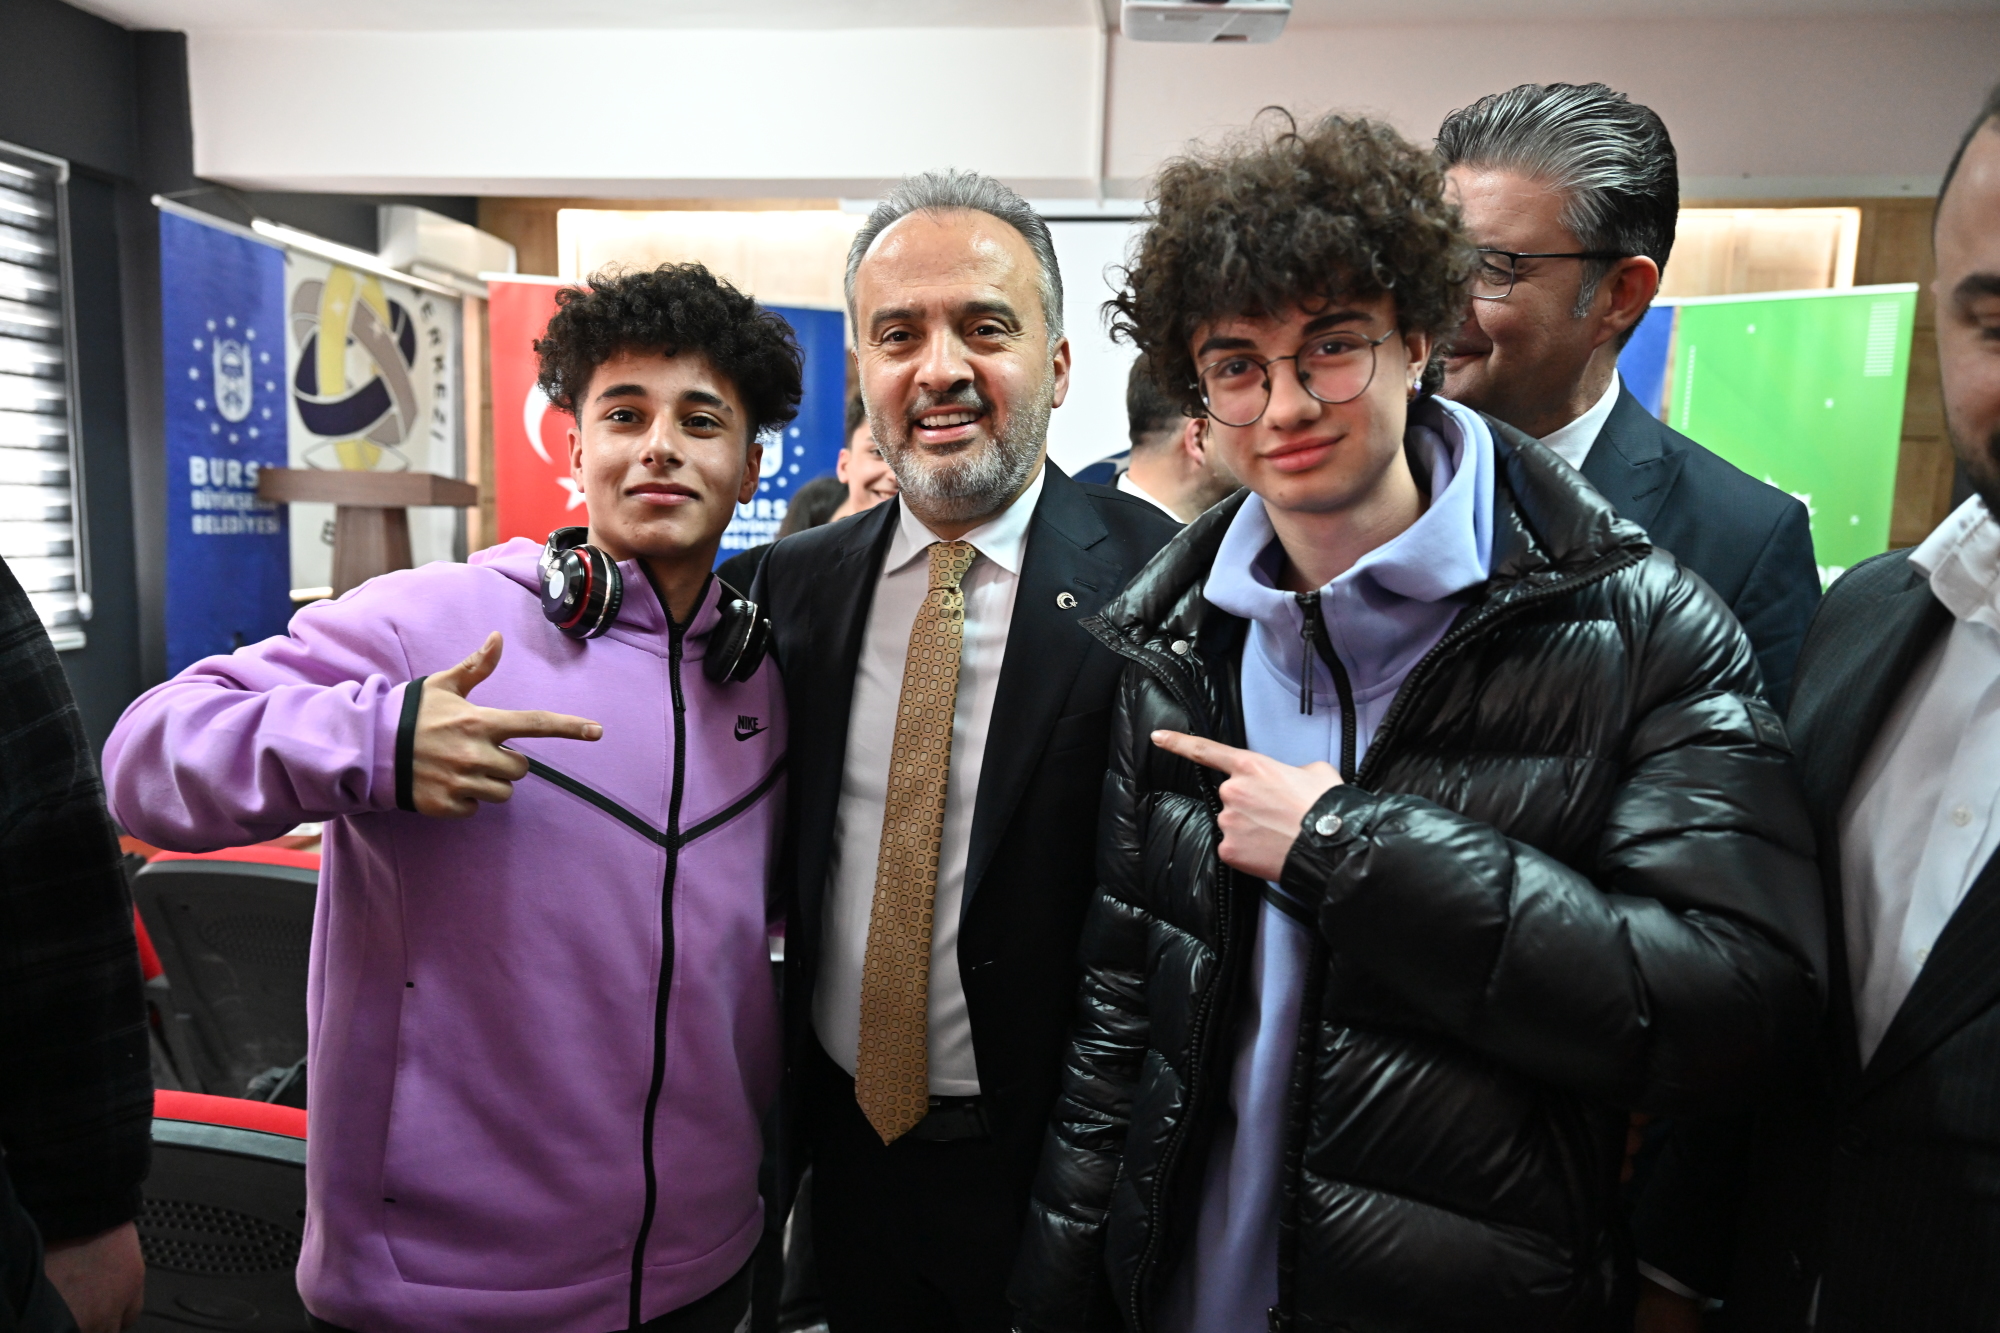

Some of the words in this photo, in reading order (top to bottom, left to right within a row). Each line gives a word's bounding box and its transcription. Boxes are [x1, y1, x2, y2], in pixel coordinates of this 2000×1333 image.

[189, 455, 274, 488] BURS
[732, 498, 788, 520] URS
[737, 715, 759, 730] NIKE
